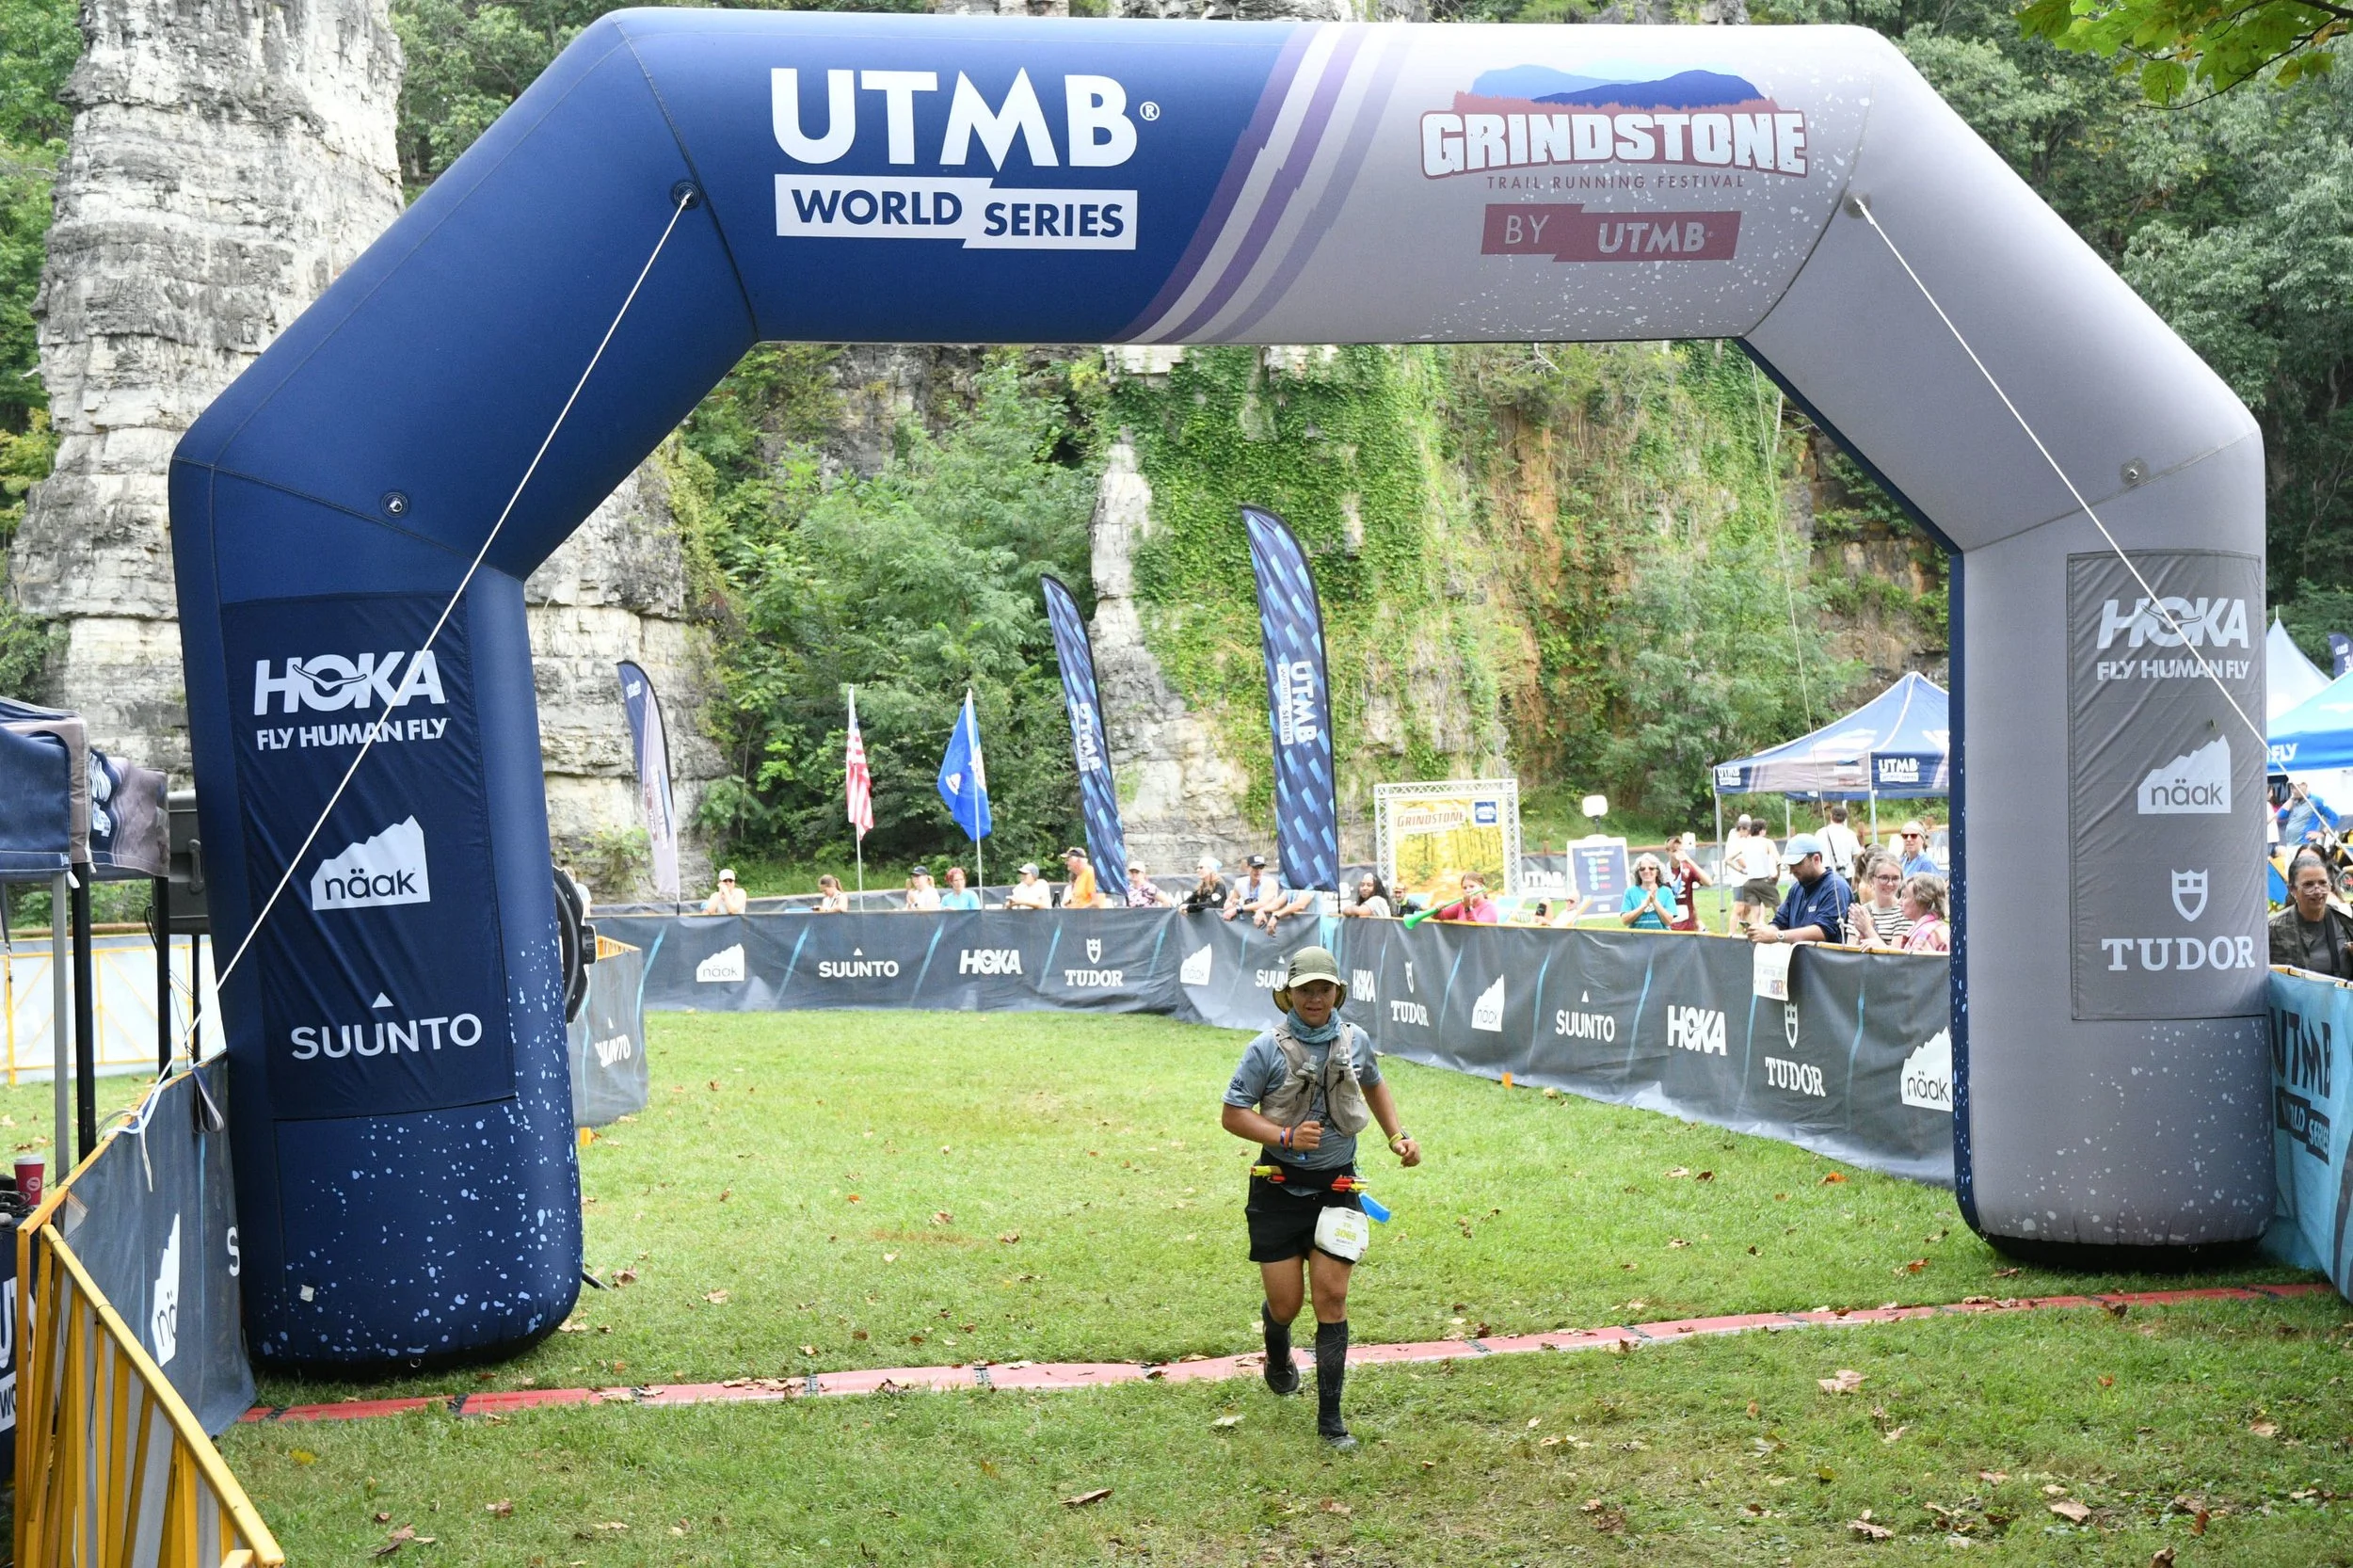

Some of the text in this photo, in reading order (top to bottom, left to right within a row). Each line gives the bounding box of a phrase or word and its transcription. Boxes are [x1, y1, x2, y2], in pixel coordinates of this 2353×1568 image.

[1422, 113, 1806, 177] GRINDSTONE
[1487, 175, 1744, 189] TRAIL RUNNING FESTIVAL
[791, 188, 1124, 237] WORLD SERIES
[1505, 215, 1550, 244] BY
[2097, 597, 2249, 649] HOKA
[254, 650, 446, 715] HOKA
[2097, 660, 2250, 680] FLY HUMAN FLY
[1290, 661, 1318, 744] UTMB
[257, 718, 448, 750] FLY HUMAN FLY
[1879, 758, 1919, 774] UTMB
[2271, 743, 2298, 762] FLY
[2152, 778, 2223, 806] näak
[1397, 811, 1465, 827] GRINDSTONE
[324, 868, 418, 901] näak
[818, 960, 899, 978] SUUNTO
[959, 949, 1023, 975] HOKA
[2101, 936, 2256, 971] TUDOR
[702, 966, 738, 977] näak
[1064, 969, 1124, 987] TUDOR
[1255, 968, 1289, 991] SUUN
[1353, 968, 1376, 1002] HOKA
[1390, 1000, 1430, 1027] TUDOR
[1555, 1009, 1615, 1043] SUUNTO
[290, 1013, 483, 1061] SUUNTO
[1667, 1005, 1728, 1056] HOKA
[2268, 1006, 2331, 1099] UTMB
[1765, 1056, 1827, 1097] TUDOR
[1907, 1071, 1950, 1103] näak
